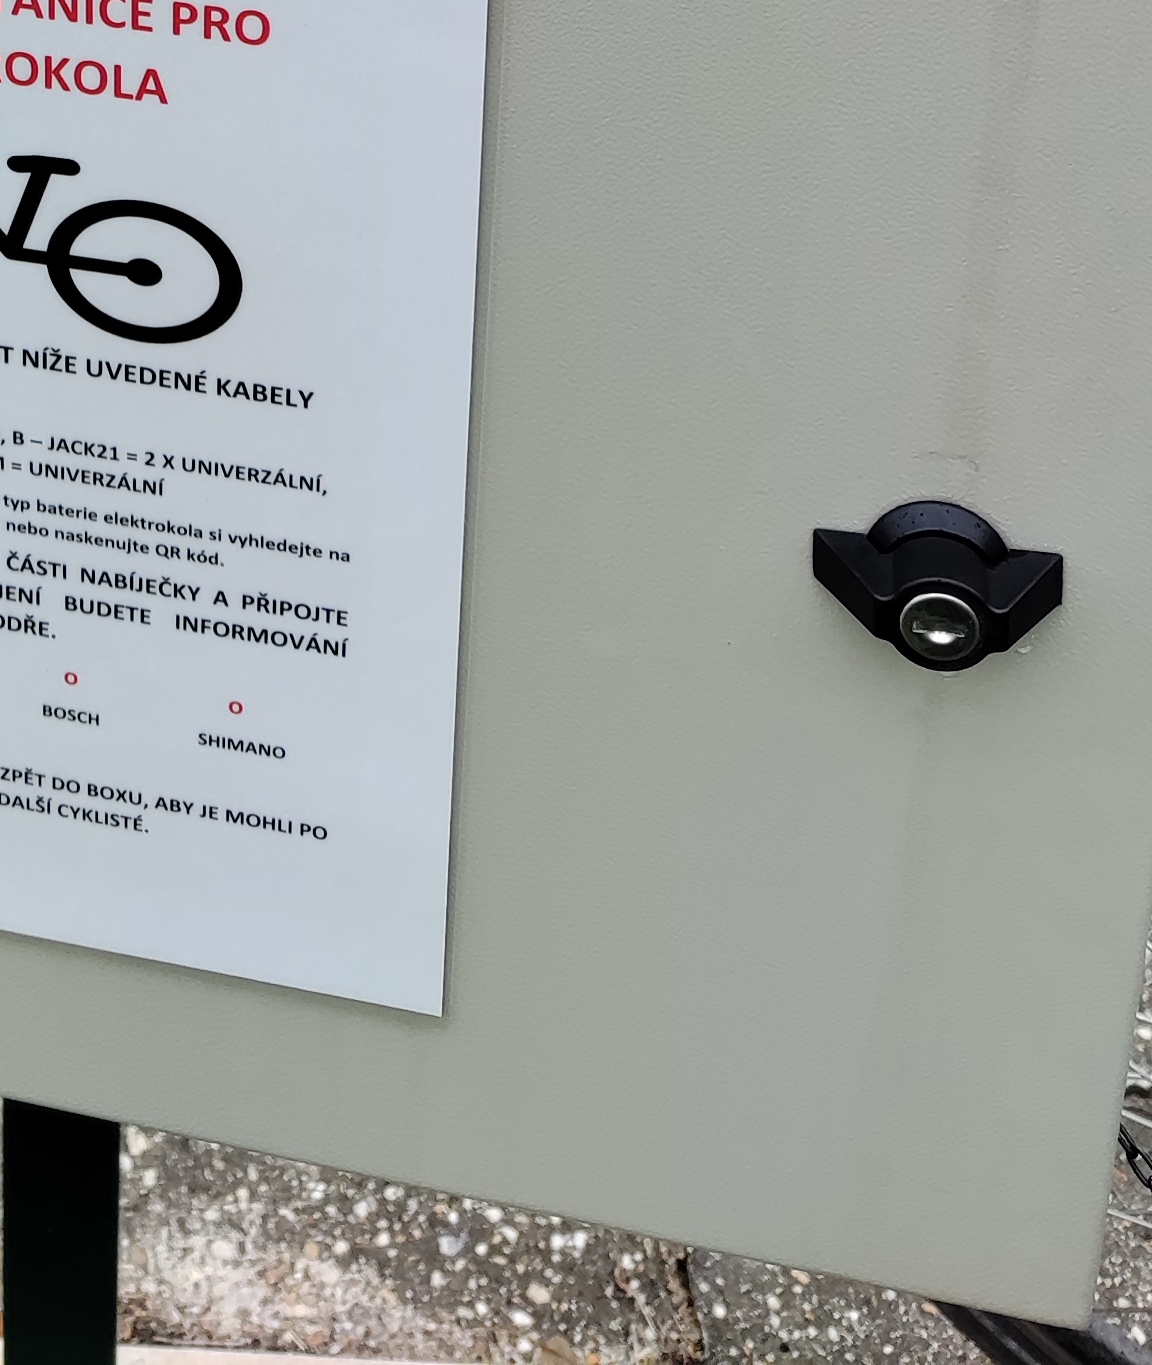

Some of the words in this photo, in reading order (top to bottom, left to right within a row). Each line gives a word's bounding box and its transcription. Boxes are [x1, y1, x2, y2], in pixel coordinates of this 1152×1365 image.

[173, 1, 270, 45] PRO
[22, 347, 77, 374] NÍŽE
[86, 358, 207, 394] UVEDENÉ
[217, 378, 314, 409] KABELY
[13, 431, 24, 445] B
[48, 436, 119, 461] JACK21
[145, 451, 155, 467] 2
[162, 454, 175, 470] X
[182, 457, 327, 496] UNIVERZÁLNÍ,
[29, 461, 165, 496] UNIVERZÁLNÍ
[3, 495, 30, 513] typ
[37, 499, 97, 522] baterie
[104, 512, 202, 539] elektrokola
[209, 529, 221, 542] si
[228, 533, 322, 558] vyhledejte
[329, 550, 350, 563] na
[6, 521, 49, 537] nebo
[55, 529, 149, 554] naskenujte
[155, 544, 181, 560] QR
[187, 548, 224, 567] kód.
[7, 550, 66, 580] ČÁSTI
[81, 567, 200, 602] NABÍJEČKY
[213, 590, 229, 607] A
[242, 592, 348, 627] PŘIPOJTE
[65, 595, 151, 625] BUDETE
[176, 614, 349, 658] INFORMOVÁNÍ
[43, 704, 99, 726] BOSCH
[198, 733, 285, 759] SHIMANO
[0, 767, 46, 787] ZPĚT
[52, 776, 80, 794] DO
[88, 783, 148, 810] BOXU,
[155, 797, 194, 815] ABY
[199, 805, 218, 820] JE
[226, 809, 292, 834] MOHLI
[300, 823, 327, 840] PO
[58, 804, 149, 834] CYKLISTÉ.
